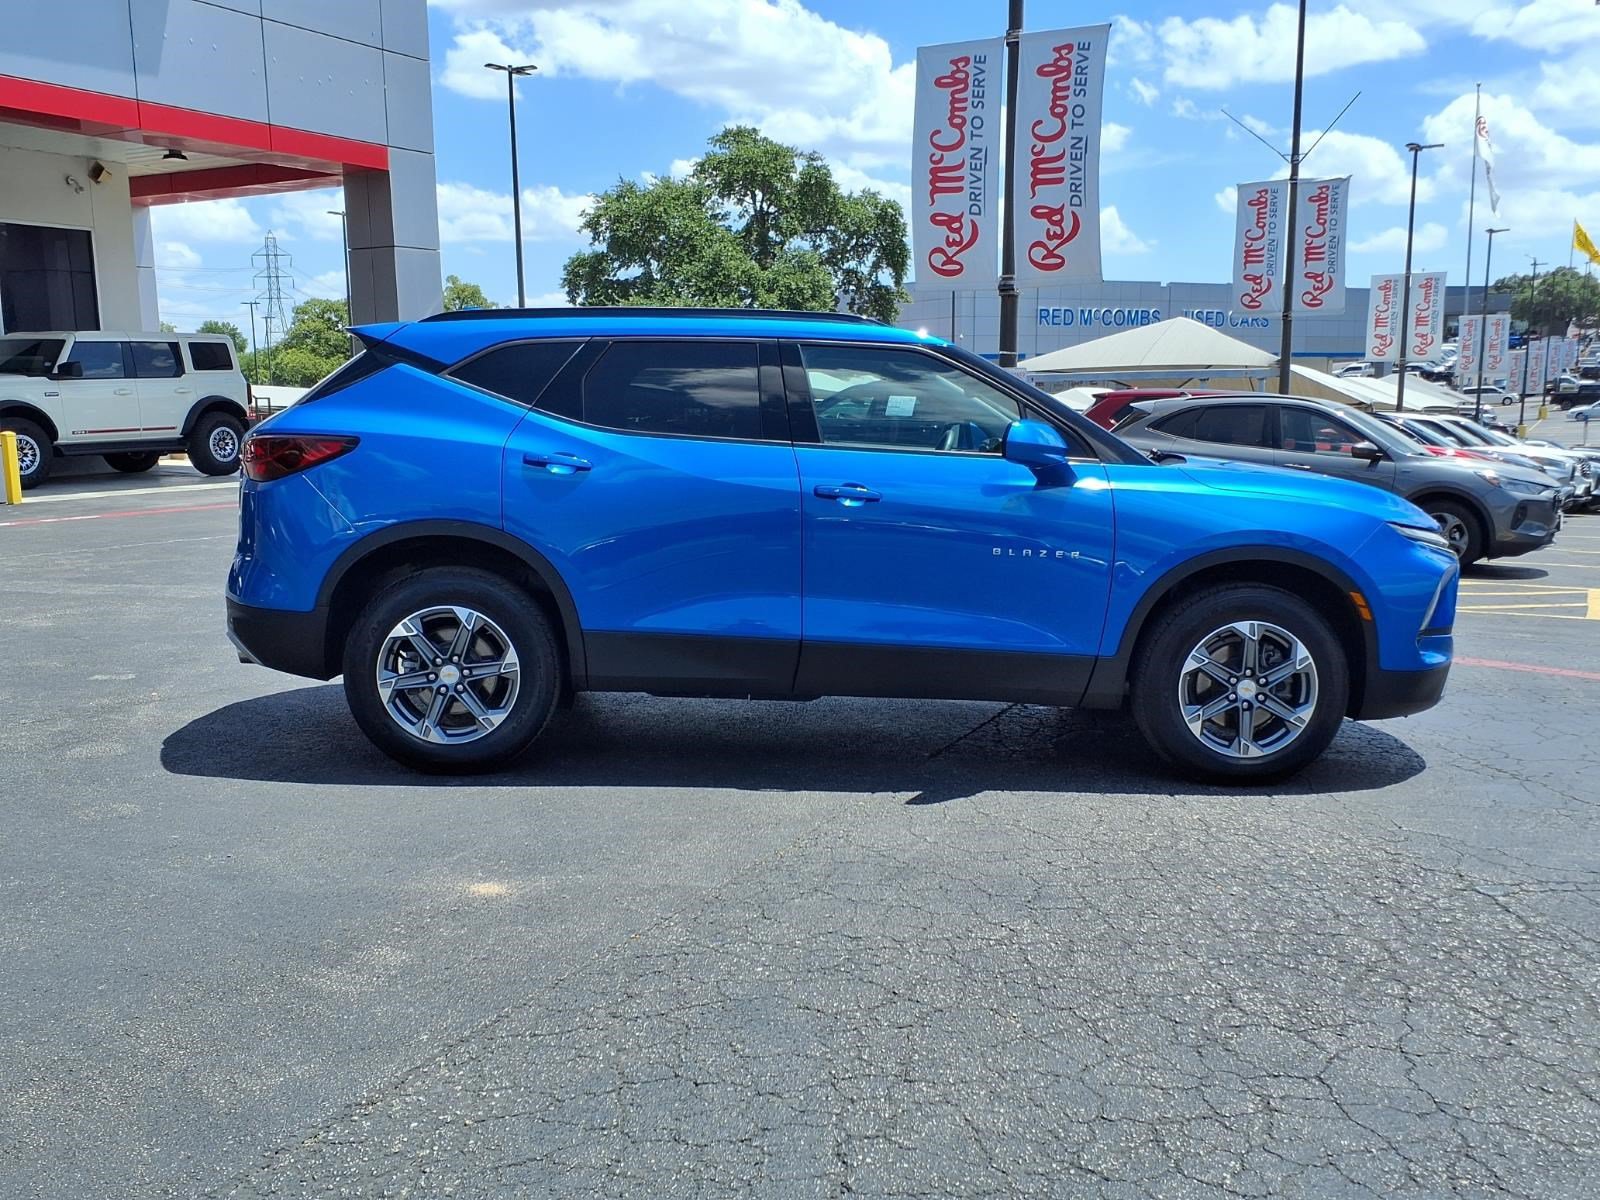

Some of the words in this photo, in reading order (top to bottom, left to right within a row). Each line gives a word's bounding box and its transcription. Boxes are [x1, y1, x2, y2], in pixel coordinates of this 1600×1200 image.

[972, 54, 987, 110] SERVE
[1074, 41, 1091, 98] SERVE
[929, 55, 971, 206] McCombs
[970, 115, 984, 141] TO
[1030, 43, 1074, 200] McCombs
[1071, 103, 1085, 130] TO
[969, 147, 983, 217] DRIVEN
[1070, 136, 1084, 208] DRIVEN
[1269, 187, 1279, 220] SERVE
[1330, 184, 1340, 216] SERVE
[1028, 203, 1081, 272] Red
[1243, 188, 1269, 270] McCombs
[1268, 221, 1277, 236] TO
[1304, 185, 1330, 268] McCombs
[1329, 218, 1338, 232] TO
[928, 211, 979, 278] Red
[1266, 238, 1276, 276] DRIVEN
[1328, 235, 1337, 274] DRIVEN
[1241, 273, 1272, 310] Red
[1302, 271, 1333, 308] Red
[1039, 308, 1074, 326] RED
[1372, 333, 1393, 357] Red
[1412, 332, 1434, 356] Red
[992, 547, 1080, 559] BLAZER
